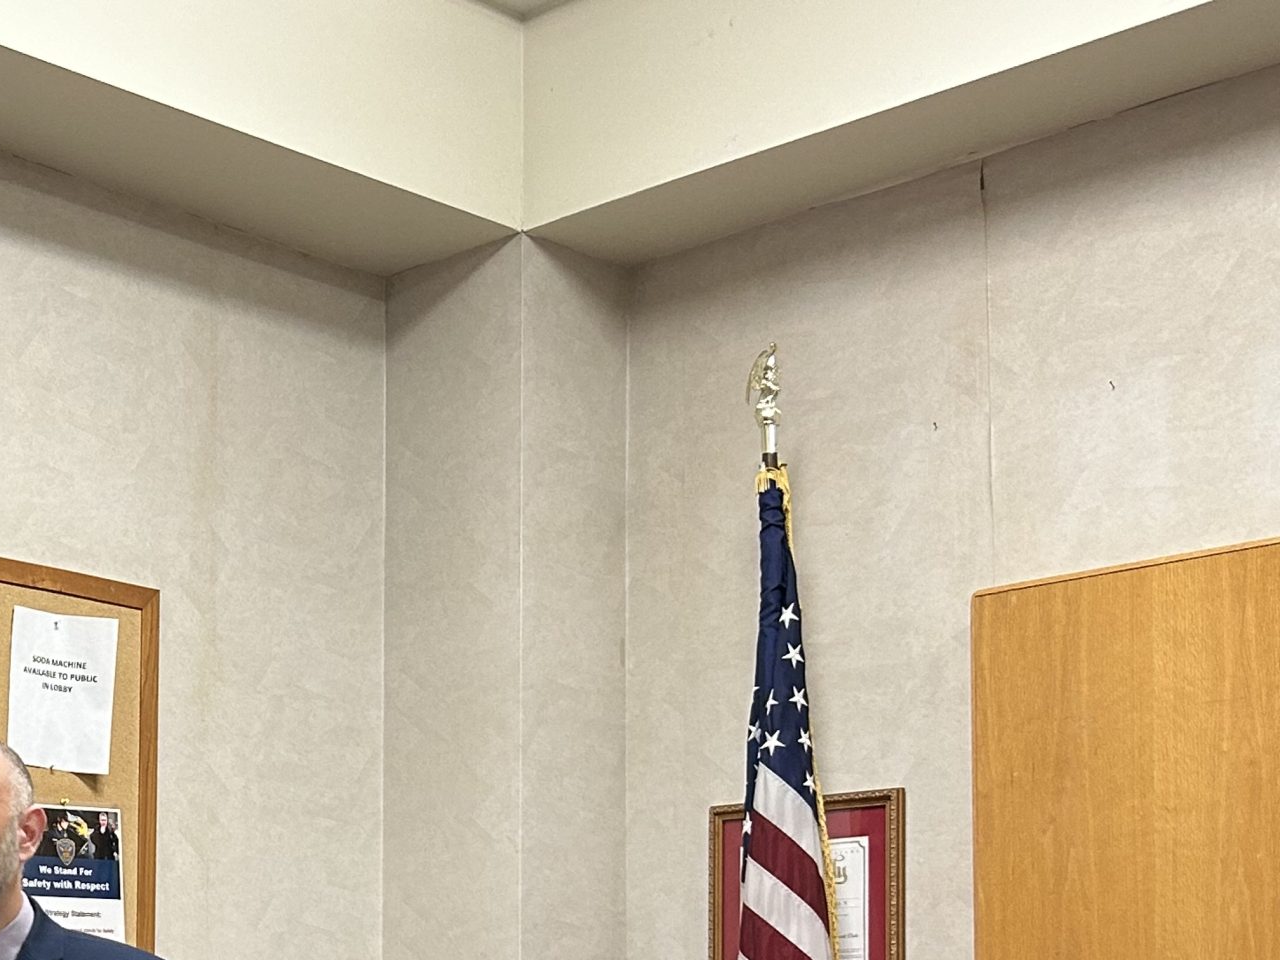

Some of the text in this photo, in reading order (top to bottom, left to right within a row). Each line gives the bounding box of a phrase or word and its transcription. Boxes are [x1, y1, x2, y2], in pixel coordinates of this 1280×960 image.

[32, 655, 88, 670] SODA MACHINE
[23, 665, 99, 683] AVAILABLE TO PUBLIC
[42, 682, 73, 693] IN LOBBY
[39, 865, 93, 876] We Stand For
[22, 878, 110, 892] Safety with Respect
